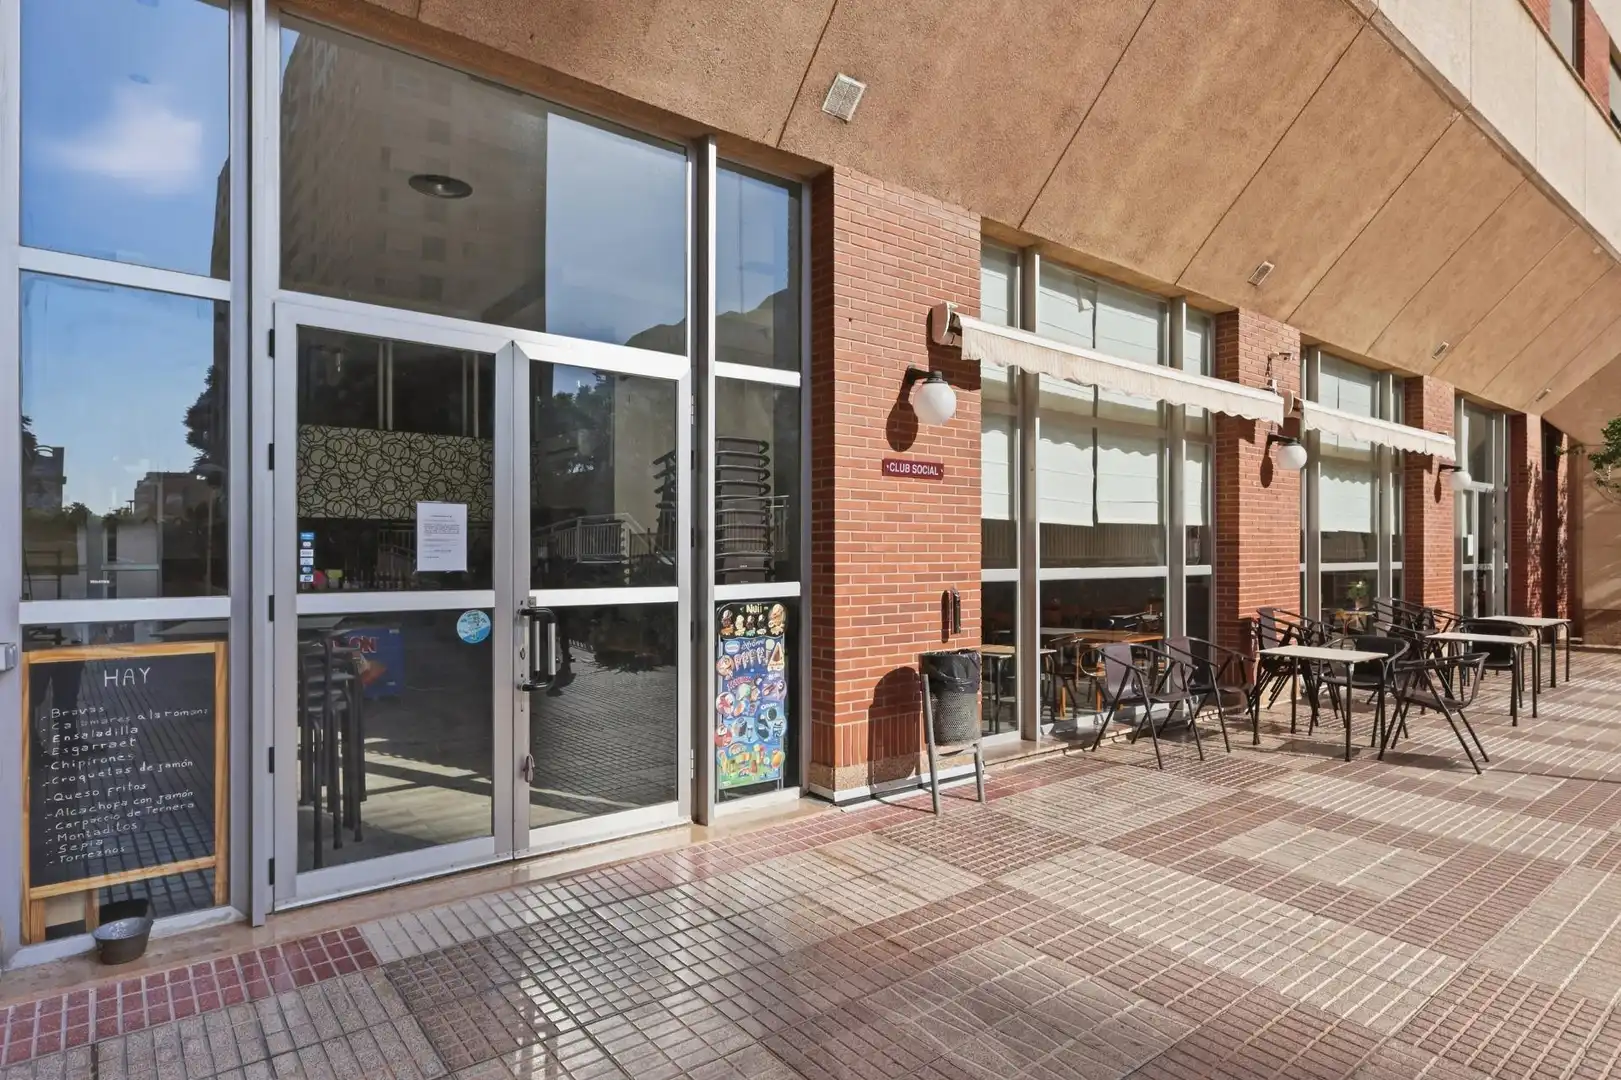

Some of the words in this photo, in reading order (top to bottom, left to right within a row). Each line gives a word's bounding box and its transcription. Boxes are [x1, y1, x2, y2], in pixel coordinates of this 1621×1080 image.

[889, 462, 911, 473] CLUB
[912, 464, 939, 476] SOCIAL
[104, 666, 151, 688] HAY
[51, 706, 104, 719] Bravas
[51, 716, 131, 730] Calamares
[137, 712, 146, 720] a
[149, 708, 161, 720] la
[52, 725, 139, 743] Ensaladilla
[51, 738, 137, 756] Esgarraet
[51, 753, 135, 771] Chipirones
[140, 761, 153, 772] de
[53, 790, 100, 802] Queso
[55, 800, 128, 818] Alcachofa
[133, 797, 153, 805] con
[55, 814, 121, 830] Carpaccio
[127, 808, 141, 818] de
[145, 802, 195, 815] Ternera
[57, 822, 138, 843] Montaditos
[58, 839, 104, 854] Sepia
[60, 846, 126, 863] Torreznos
